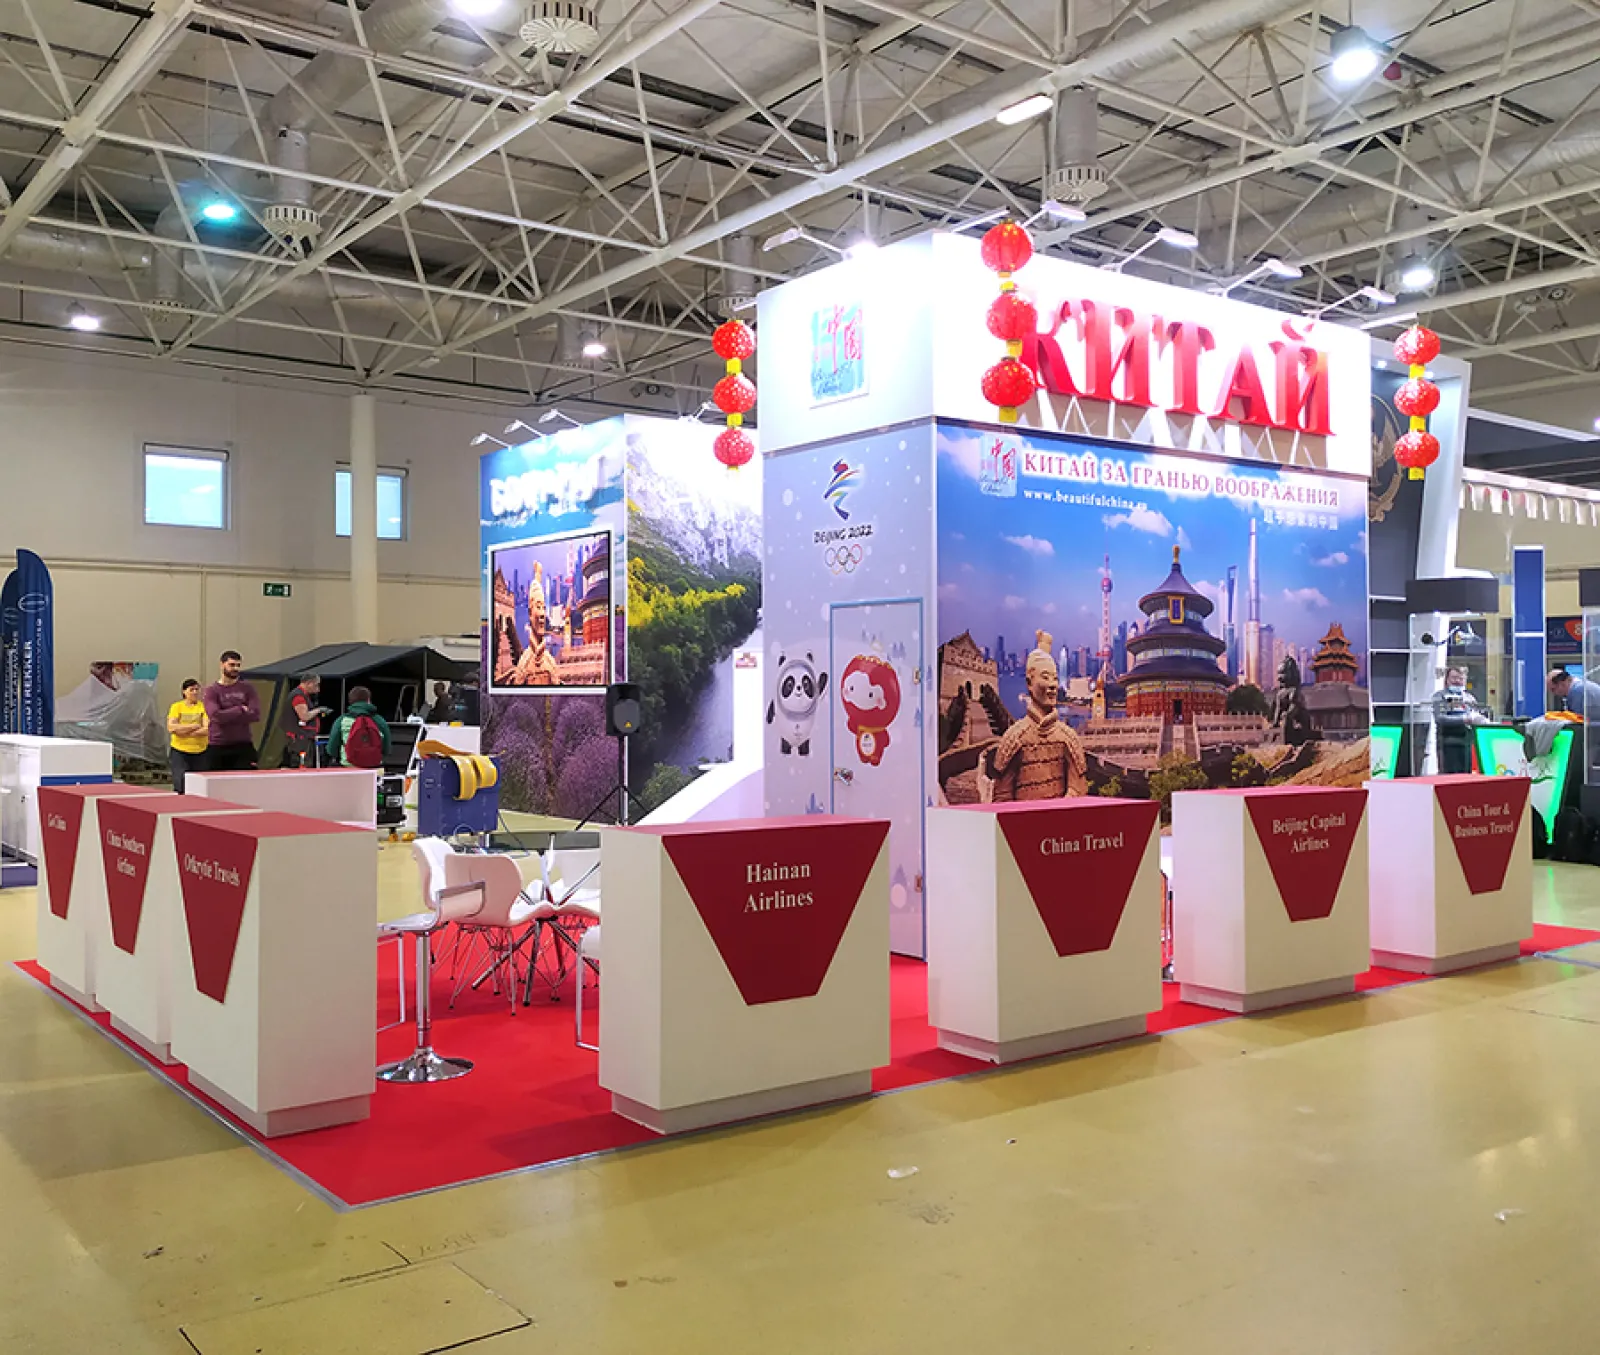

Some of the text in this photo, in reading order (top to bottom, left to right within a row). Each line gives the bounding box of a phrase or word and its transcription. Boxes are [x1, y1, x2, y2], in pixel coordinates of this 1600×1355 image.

[1019, 299, 1336, 436] КИТАЙ
[1025, 453, 1338, 506] КИТАЙ ЗА ГРАНЬЮ ВООБРАЖЕНИЯ
[814, 524, 873, 545] BEIJING 2022
[1457, 802, 1510, 818] China Tour &
[1272, 812, 1346, 836] Beijing Capital
[1454, 820, 1514, 838] Business Travel
[107, 829, 145, 856] China Southern
[1041, 832, 1124, 855] China Travel
[1291, 837, 1329, 853] Airlines
[117, 857, 135, 877] Airlines
[213, 861, 240, 887] Travels
[746, 862, 811, 883] Hainan
[743, 890, 814, 913] Airlines
